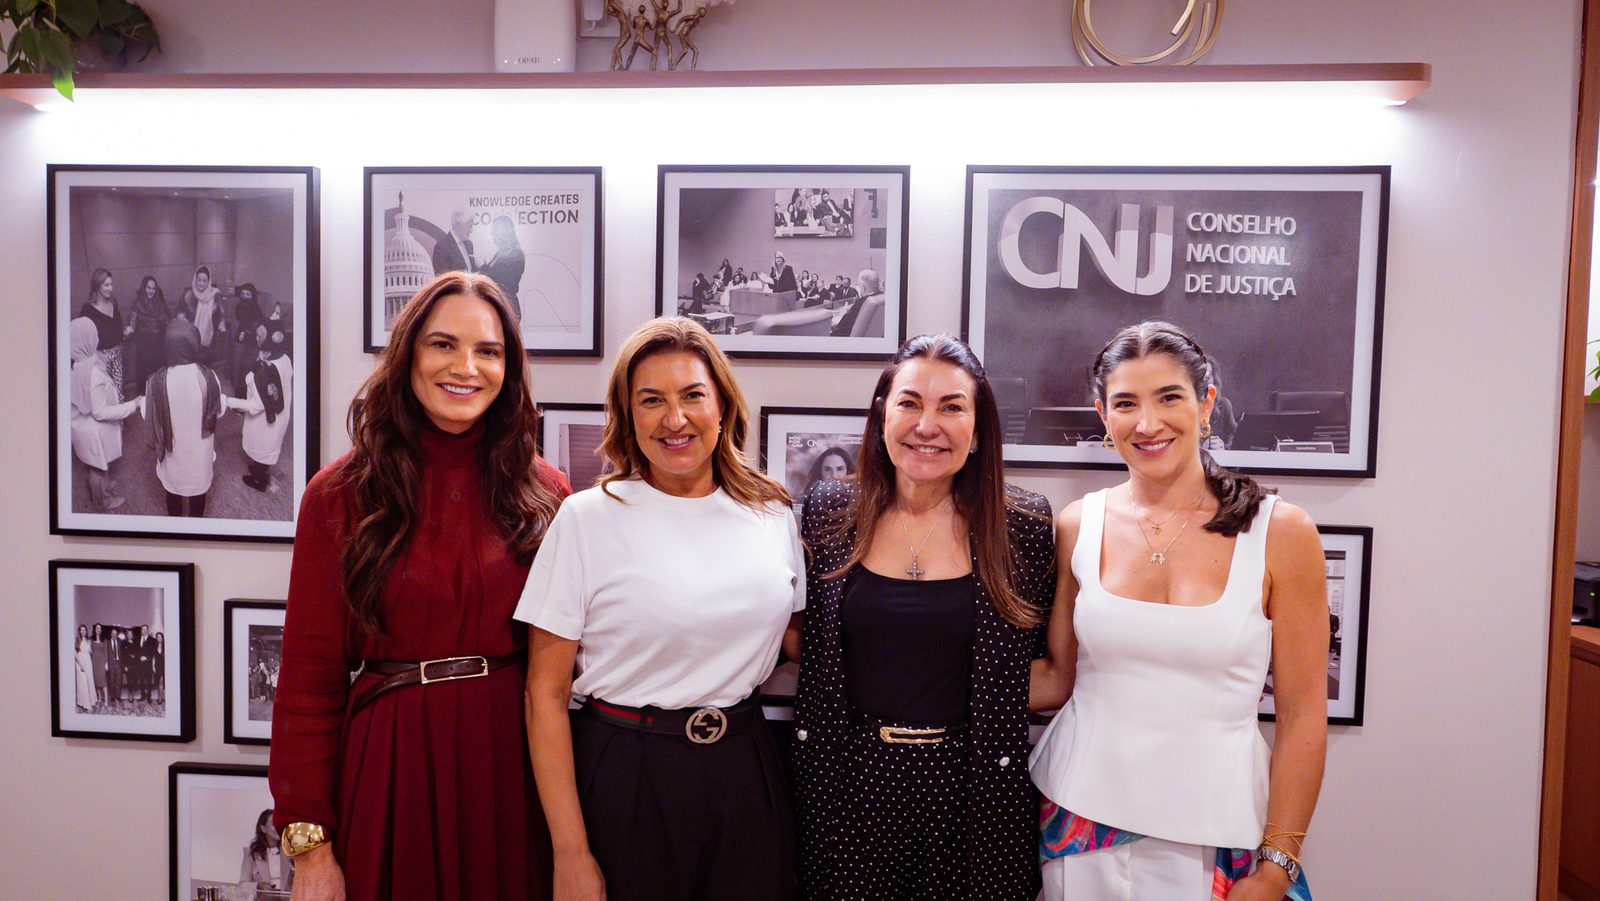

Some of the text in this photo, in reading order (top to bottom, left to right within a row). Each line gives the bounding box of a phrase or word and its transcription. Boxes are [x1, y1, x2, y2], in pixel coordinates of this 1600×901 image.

[469, 194, 580, 207] KNOWLEDGE CREATES
[472, 210, 579, 225] COECTION
[1186, 212, 1297, 236] CONSELHO
[998, 196, 1174, 296] CNJ
[1186, 243, 1291, 265] NACIONAL
[1185, 274, 1297, 300] DE JUSTIÇA
